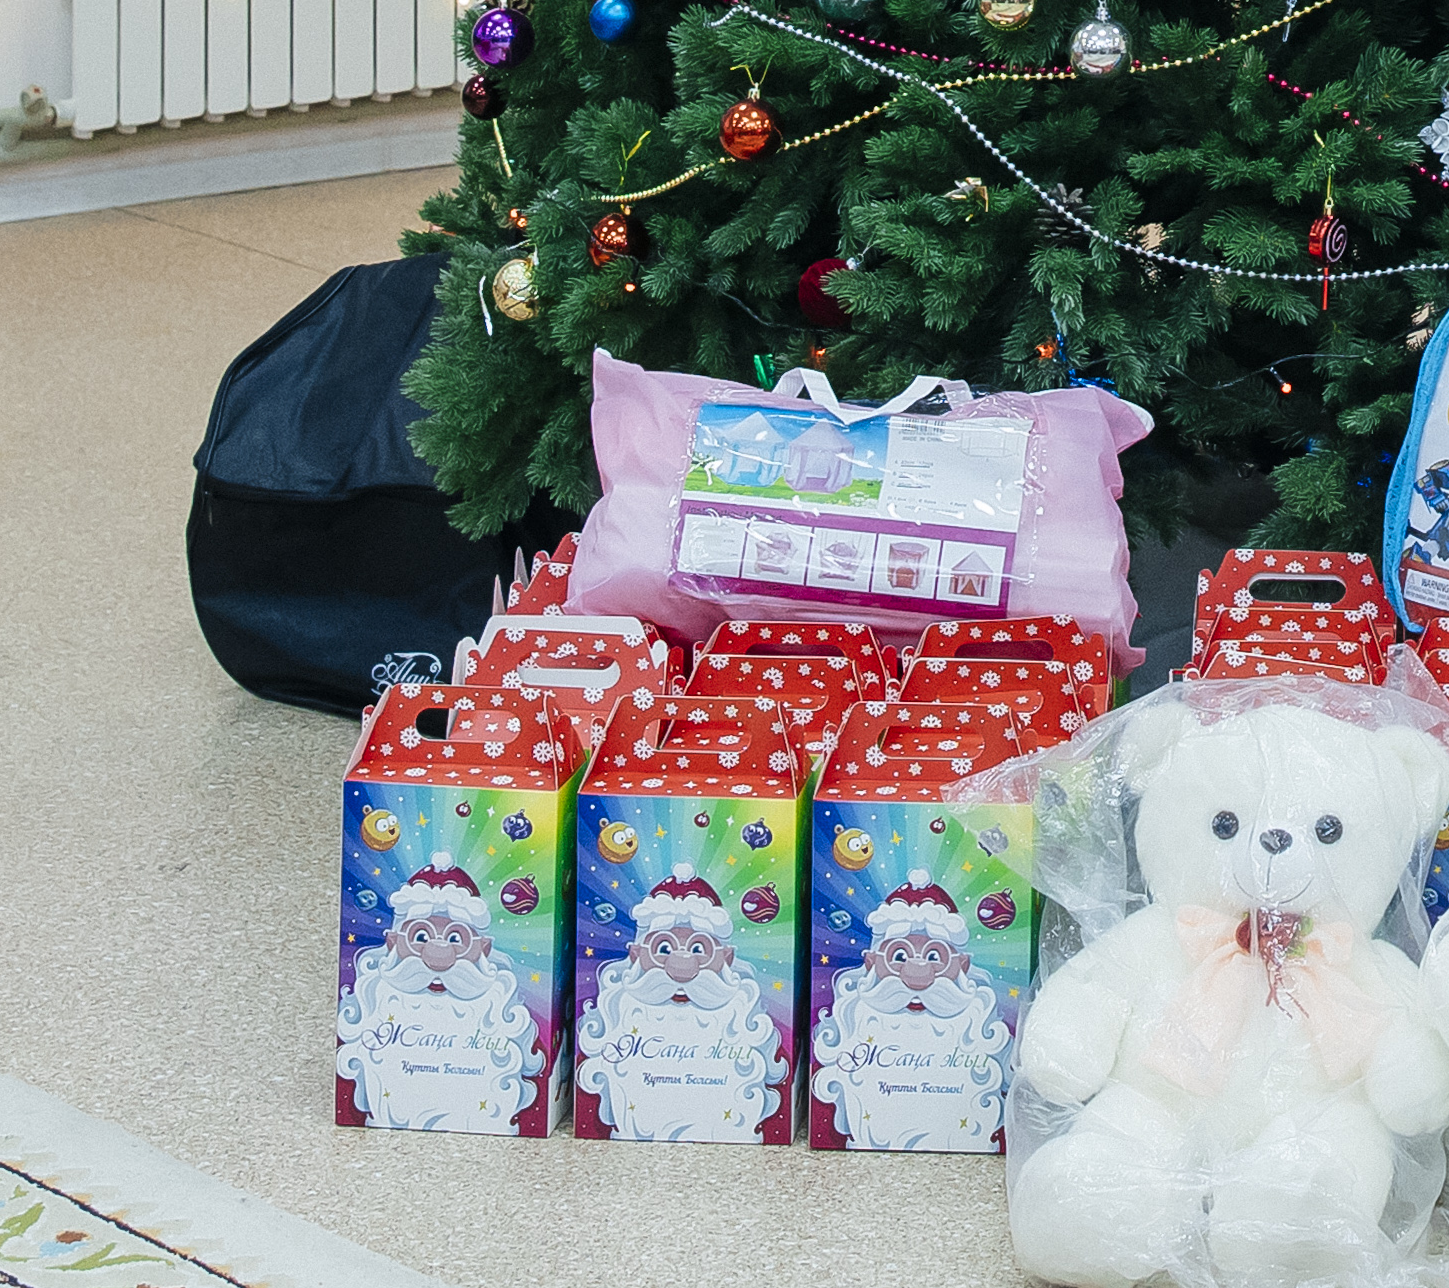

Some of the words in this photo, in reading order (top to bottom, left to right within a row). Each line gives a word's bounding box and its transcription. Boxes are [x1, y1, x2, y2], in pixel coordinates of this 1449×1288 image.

[361, 1021, 457, 1052] Жаңа
[601, 1033, 700, 1063] Жаңа
[836, 1042, 935, 1072] Жаңа
